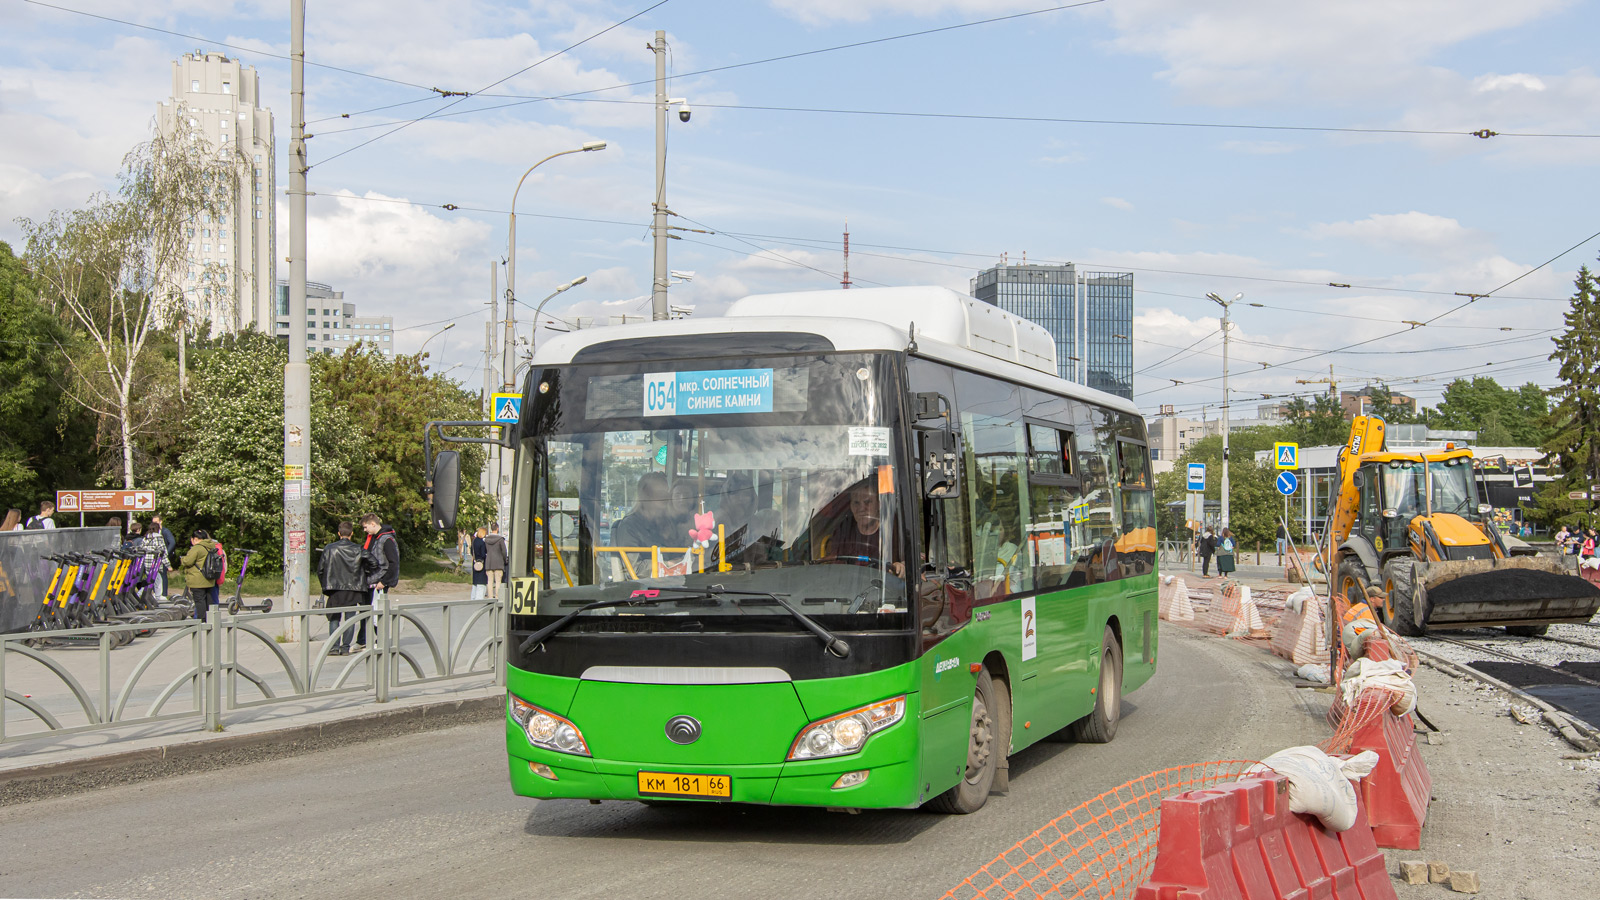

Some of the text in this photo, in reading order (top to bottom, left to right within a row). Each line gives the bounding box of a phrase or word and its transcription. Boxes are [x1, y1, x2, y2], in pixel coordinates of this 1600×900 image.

[679, 372, 770, 394] мкр. СОЛНЕЧНЫЙ
[648, 381, 675, 411] 054
[687, 393, 761, 409] СИНИЕ КАМНИ
[510, 580, 536, 613] 54
[673, 776, 699, 792] 181
[709, 778, 724, 789] 66
